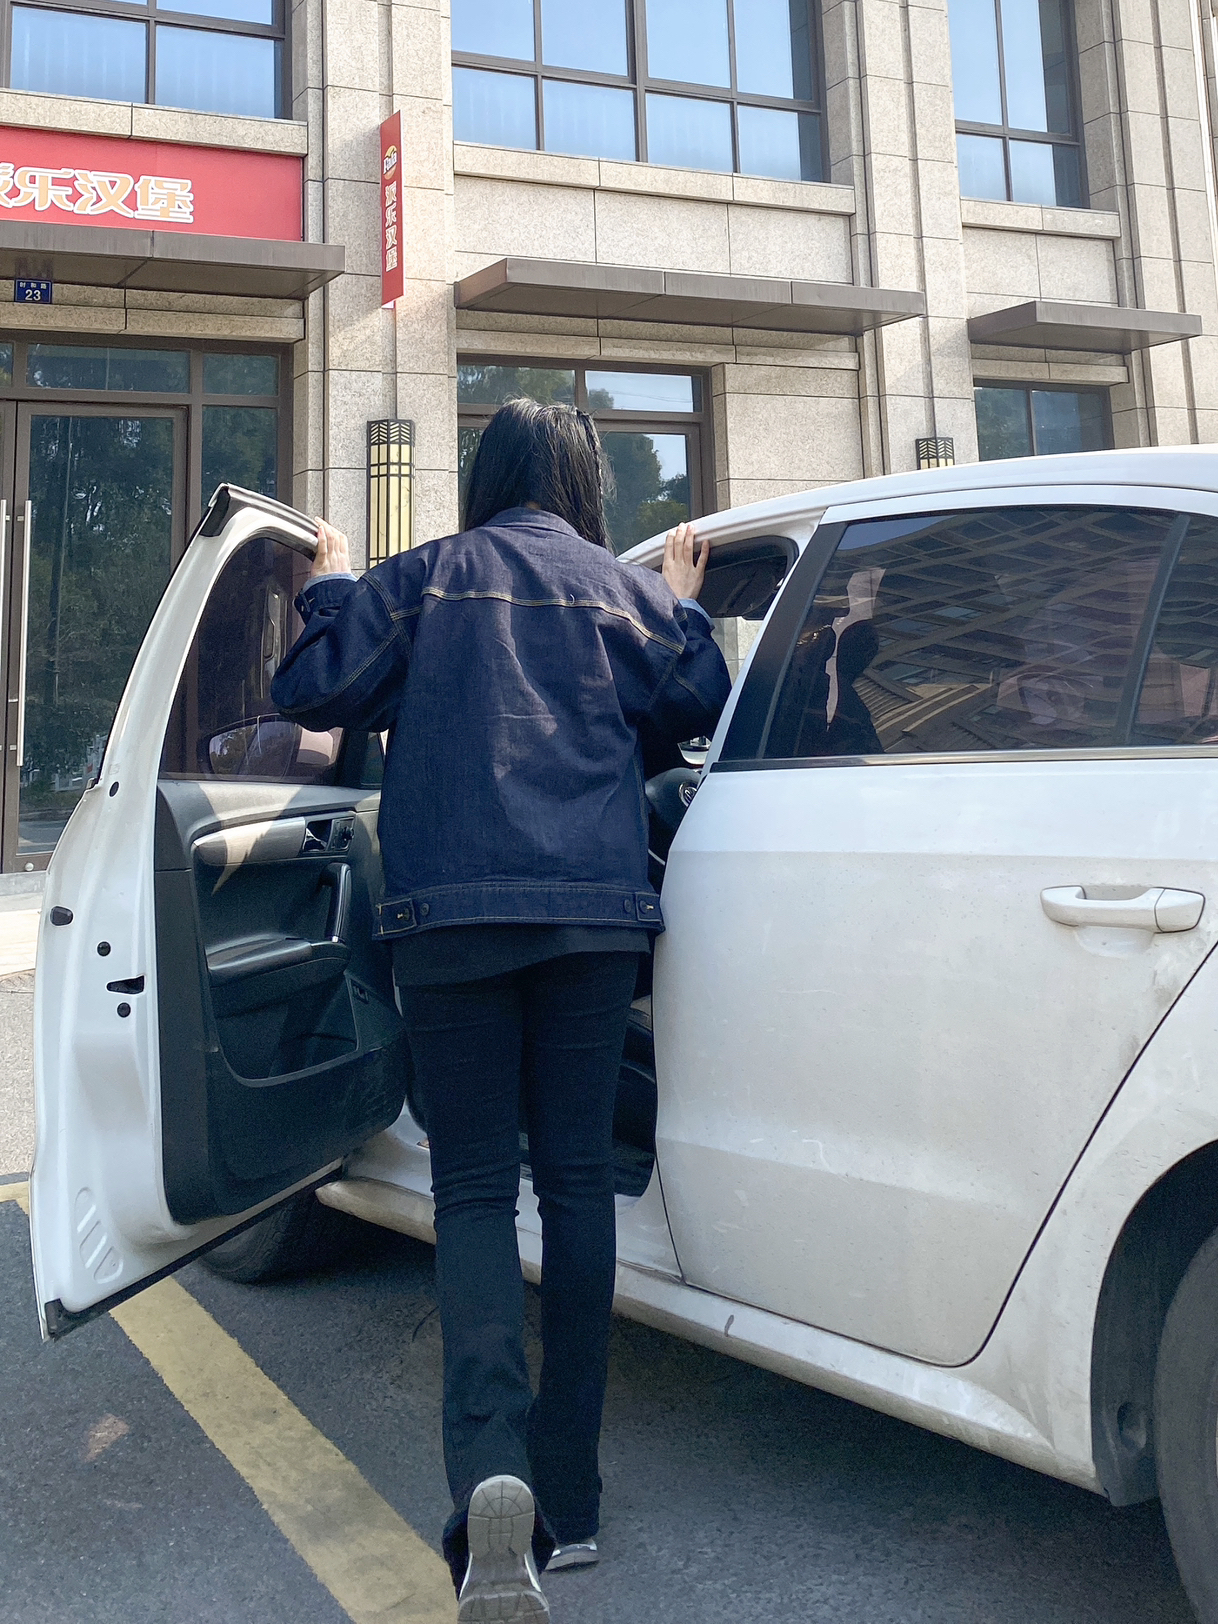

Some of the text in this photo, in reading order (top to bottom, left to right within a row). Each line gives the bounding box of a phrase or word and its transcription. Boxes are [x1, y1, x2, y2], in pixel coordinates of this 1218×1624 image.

[0, 162, 194, 223] 乐汉堡
[25, 289, 41, 301] 23
